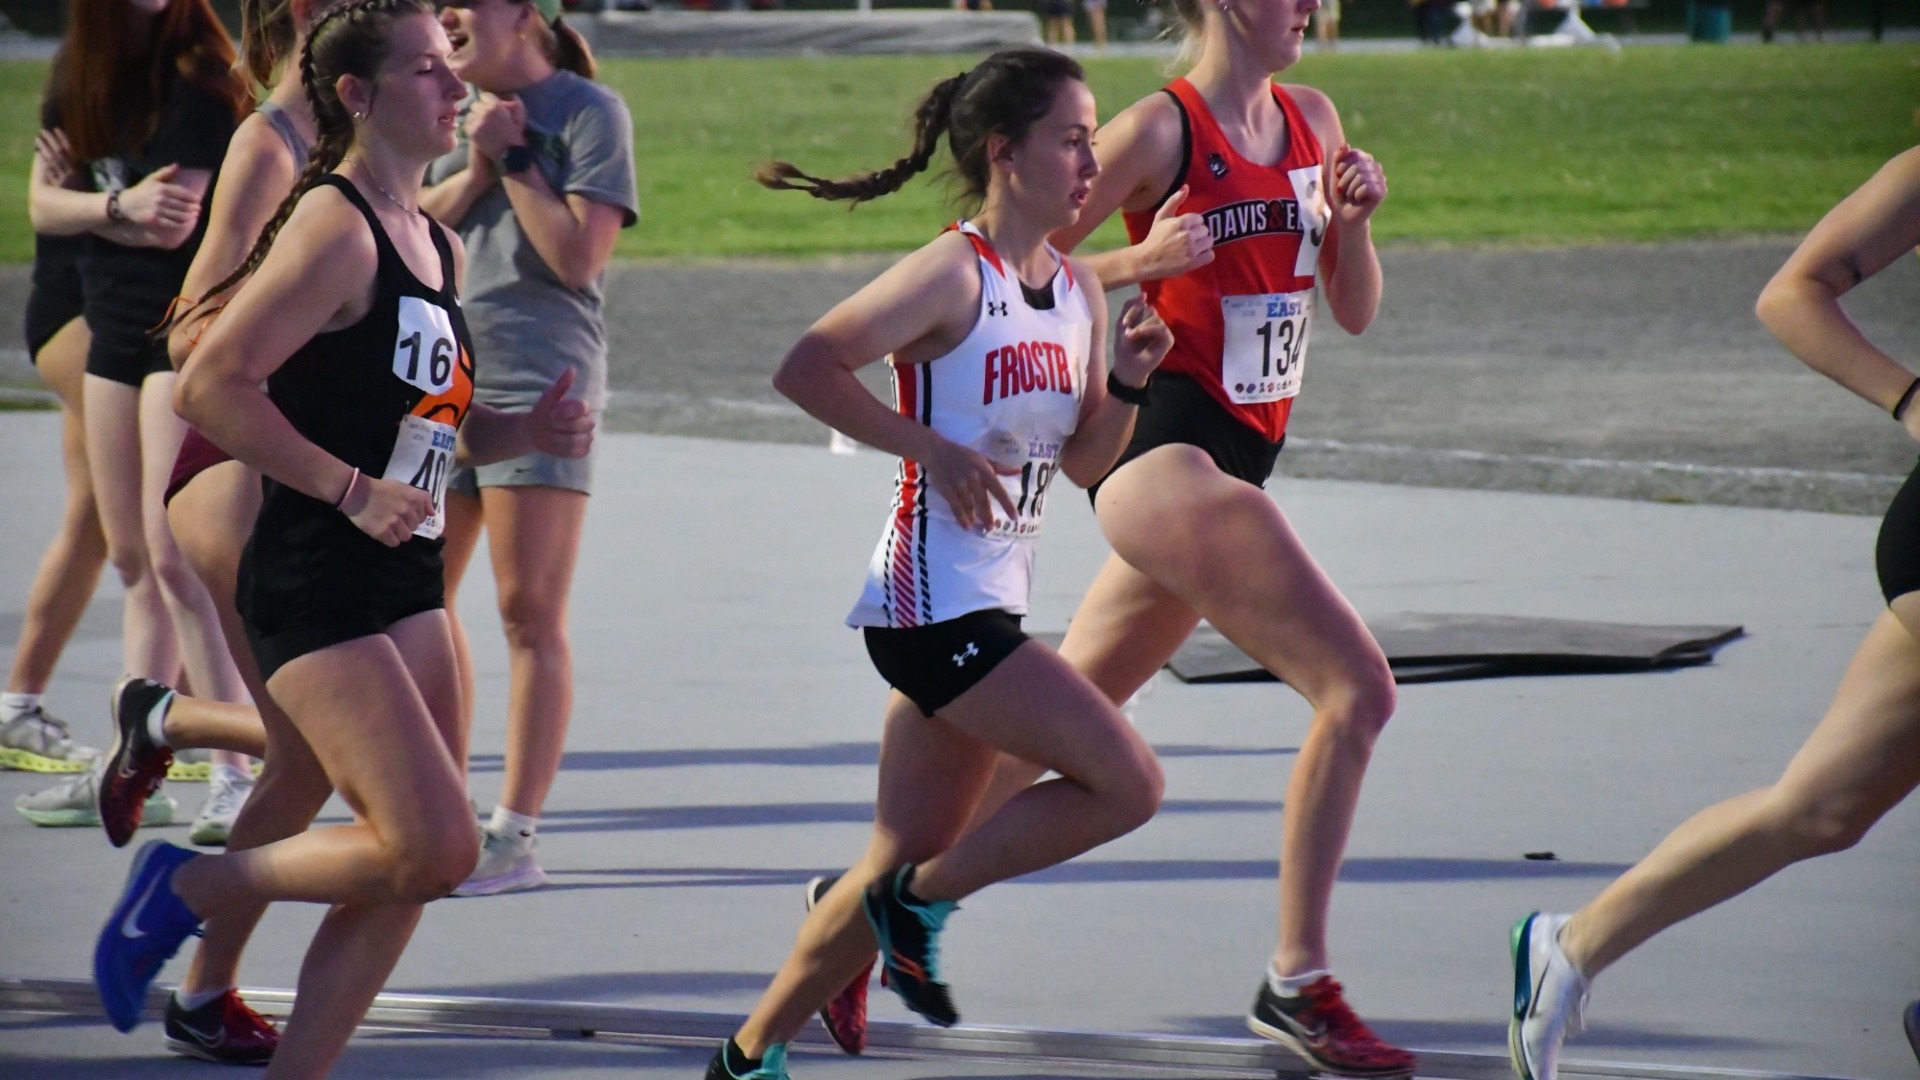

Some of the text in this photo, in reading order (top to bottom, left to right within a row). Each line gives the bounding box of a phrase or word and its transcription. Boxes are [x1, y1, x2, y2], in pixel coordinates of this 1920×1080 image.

[1265, 301, 1302, 318] EAST
[399, 330, 453, 388] 16
[982, 340, 1073, 406] FROSTB
[1256, 317, 1307, 377] 134
[1028, 442, 1060, 460] EAST
[408, 447, 447, 515] 40
[1017, 461, 1056, 518] 18
